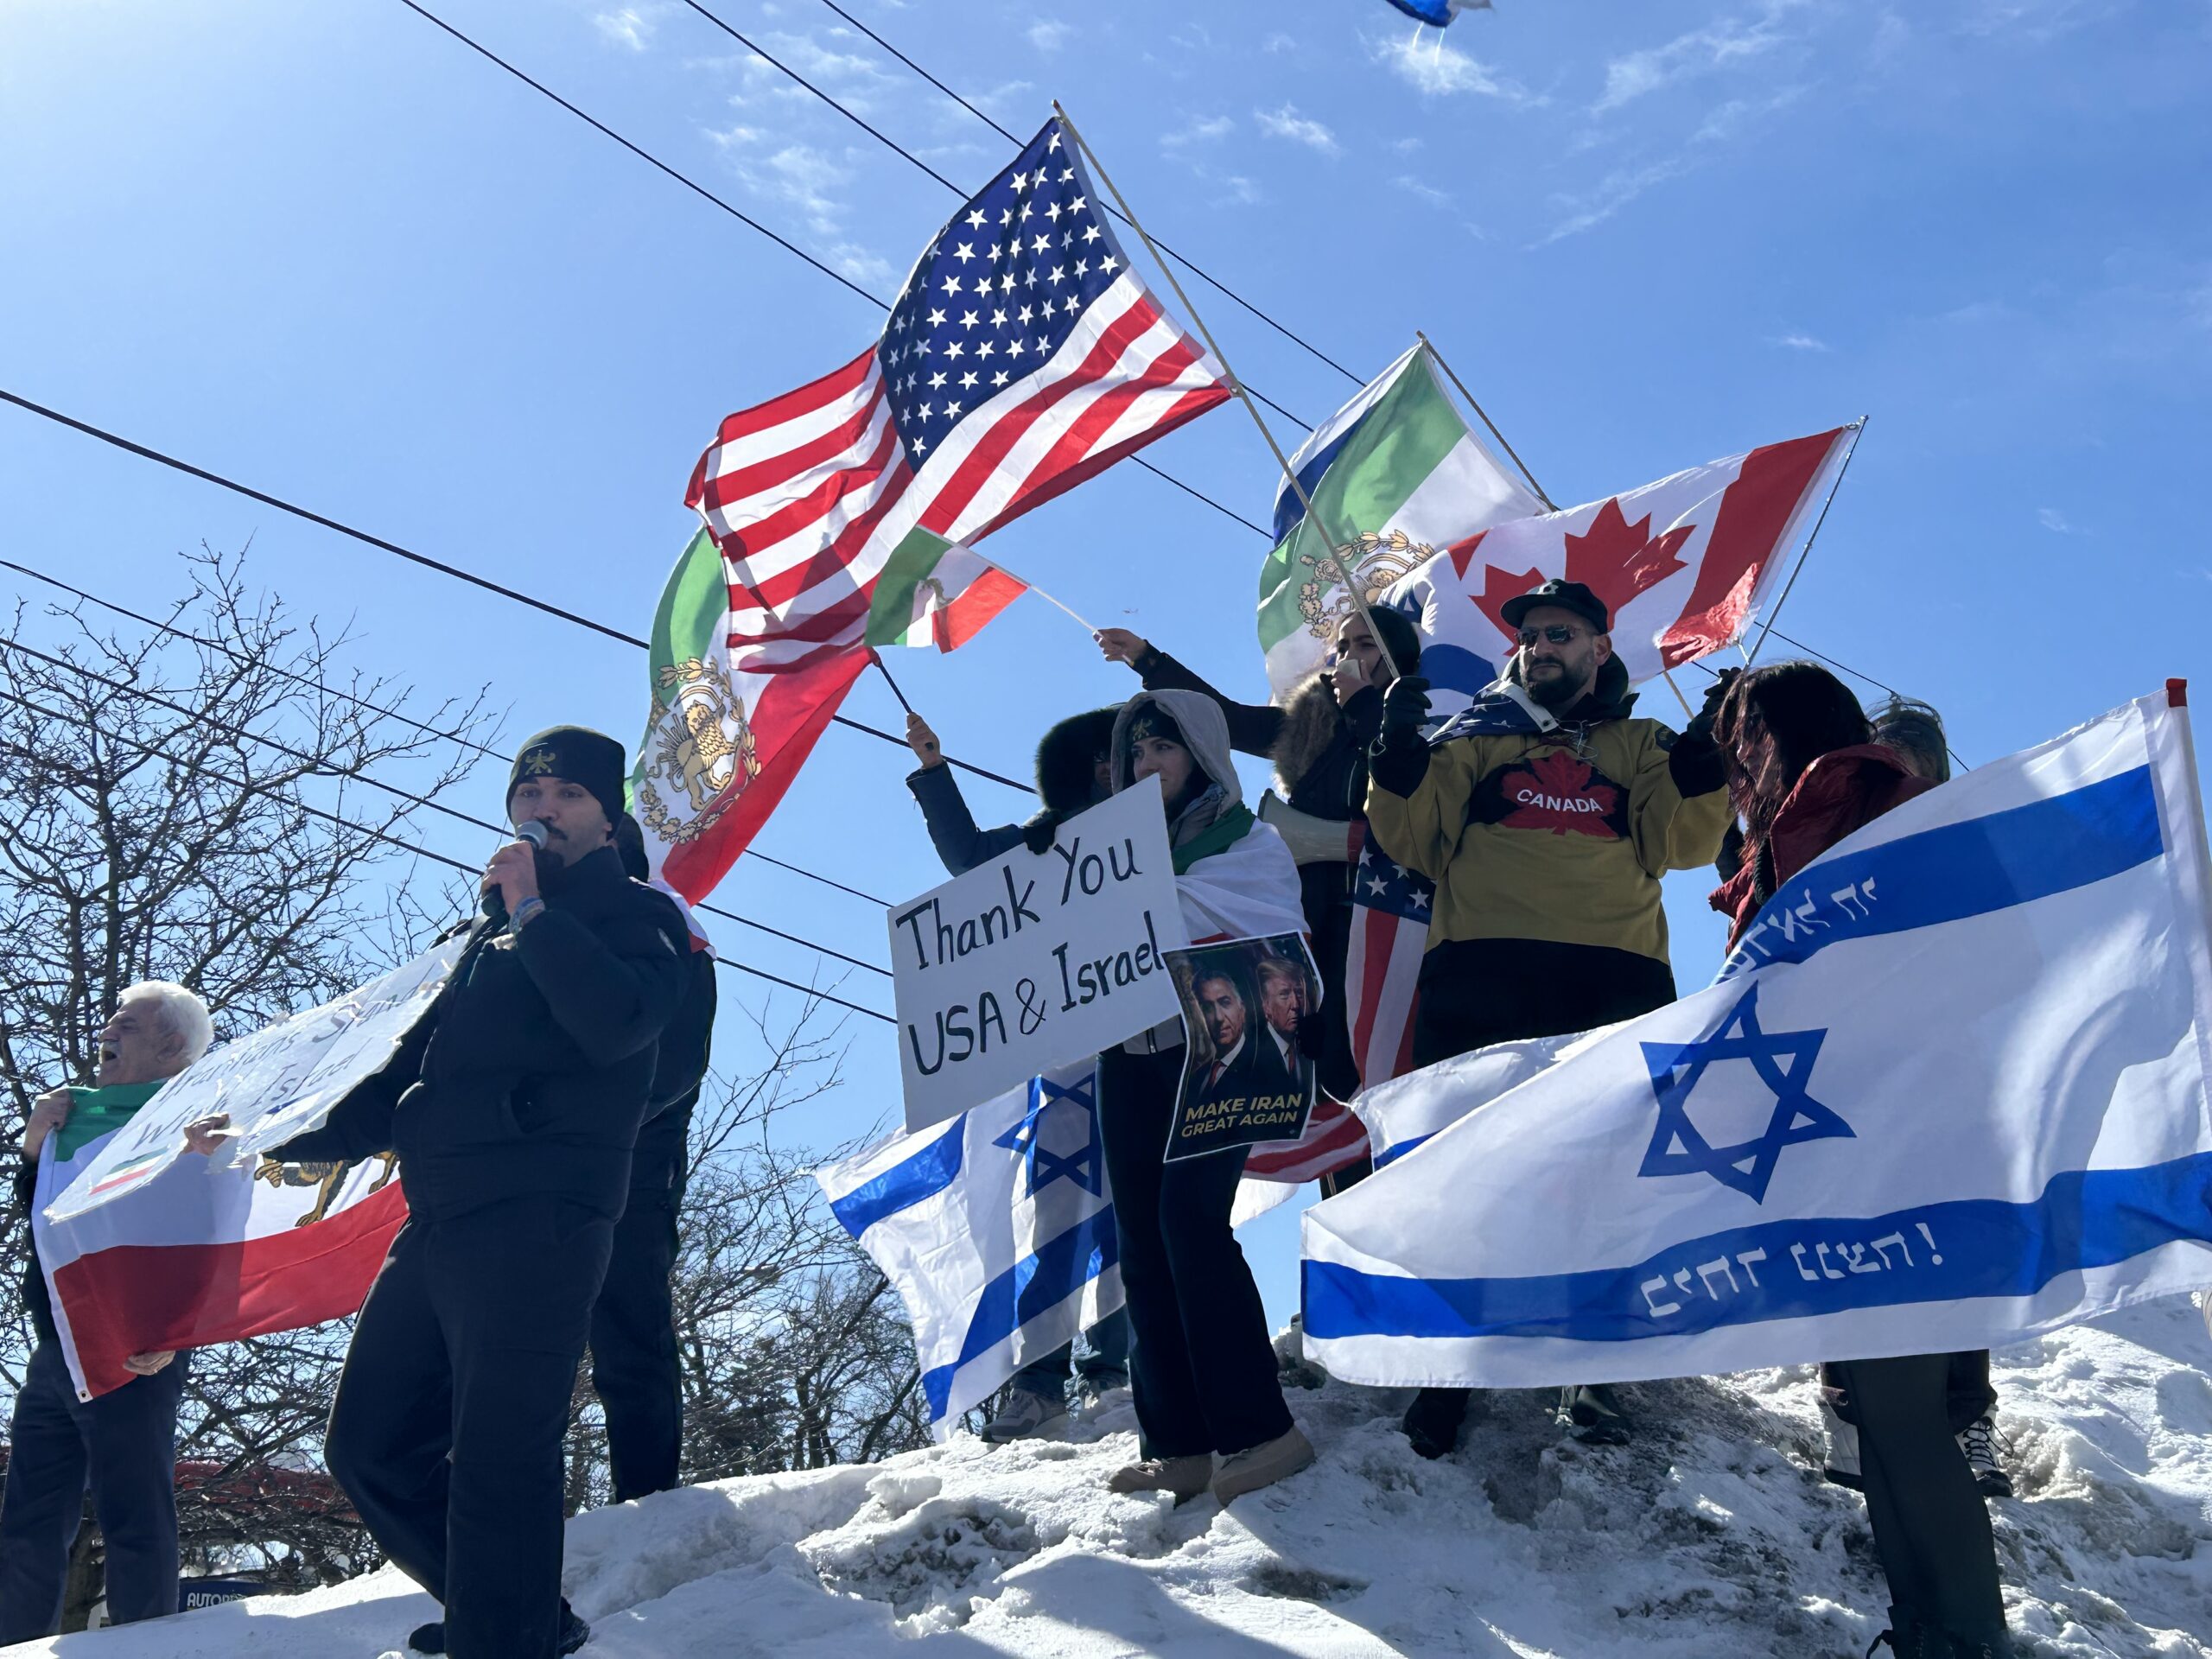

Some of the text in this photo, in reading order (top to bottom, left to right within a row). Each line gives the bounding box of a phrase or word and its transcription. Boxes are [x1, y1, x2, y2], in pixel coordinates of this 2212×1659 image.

[1516, 789, 1604, 813] CANADA
[895, 836, 1143, 970] Thank You
[908, 910, 1165, 1076] USA & Israel
[1185, 1092, 1302, 1122] MAKE IRAN
[1181, 1110, 1298, 1138] GREAT AGAIN
